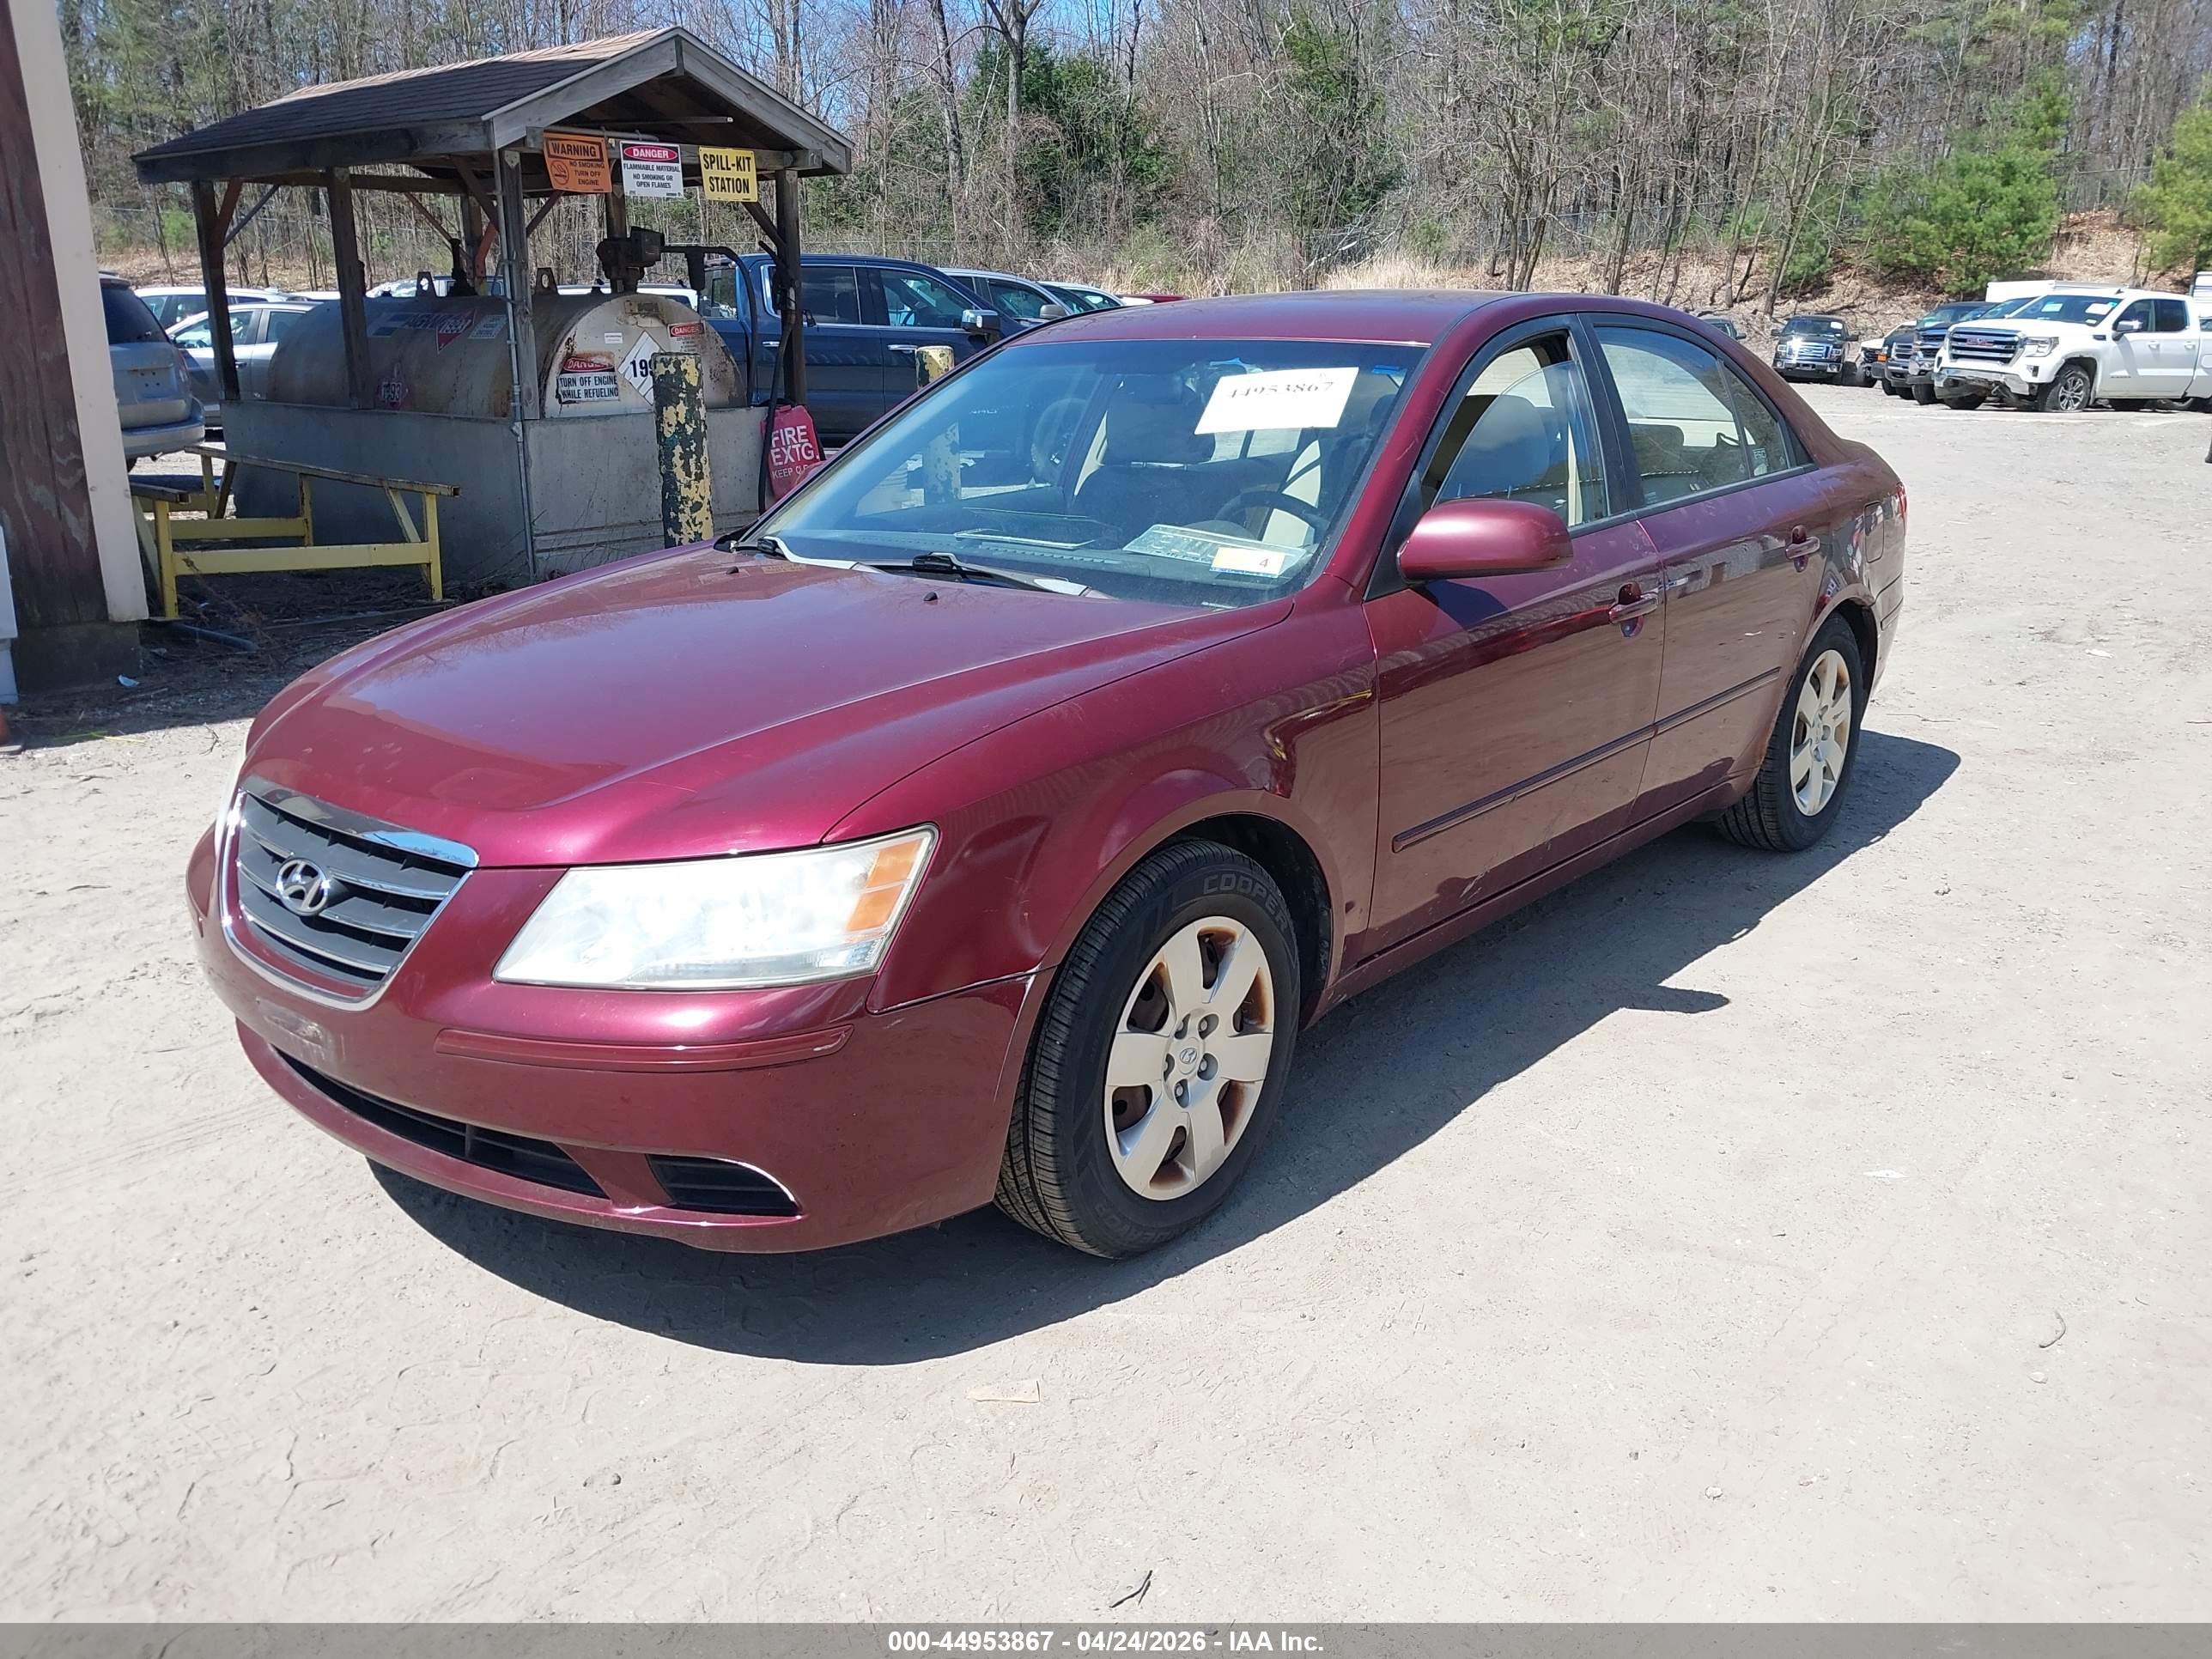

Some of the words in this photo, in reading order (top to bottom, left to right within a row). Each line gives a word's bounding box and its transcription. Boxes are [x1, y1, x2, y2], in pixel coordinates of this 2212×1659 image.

[551, 142, 597, 157] WARNING
[632, 148, 669, 159] DANGER
[623, 163, 655, 172] FLAMMABLE
[702, 153, 751, 173] SPILL-KIT
[708, 175, 750, 194] STATION
[674, 326, 700, 335] DANGER
[560, 377, 577, 388] TURN
[580, 376, 592, 386] OFF
[594, 375, 618, 386] ENGINE
[561, 388, 581, 399] WHILE
[584, 386, 619, 398] REFUELING
[771, 425, 809, 448] FIRE
[770, 442, 820, 466] EXTG.
[772, 467, 793, 479] KEEP
[1203, 873, 1289, 933] COOPER
